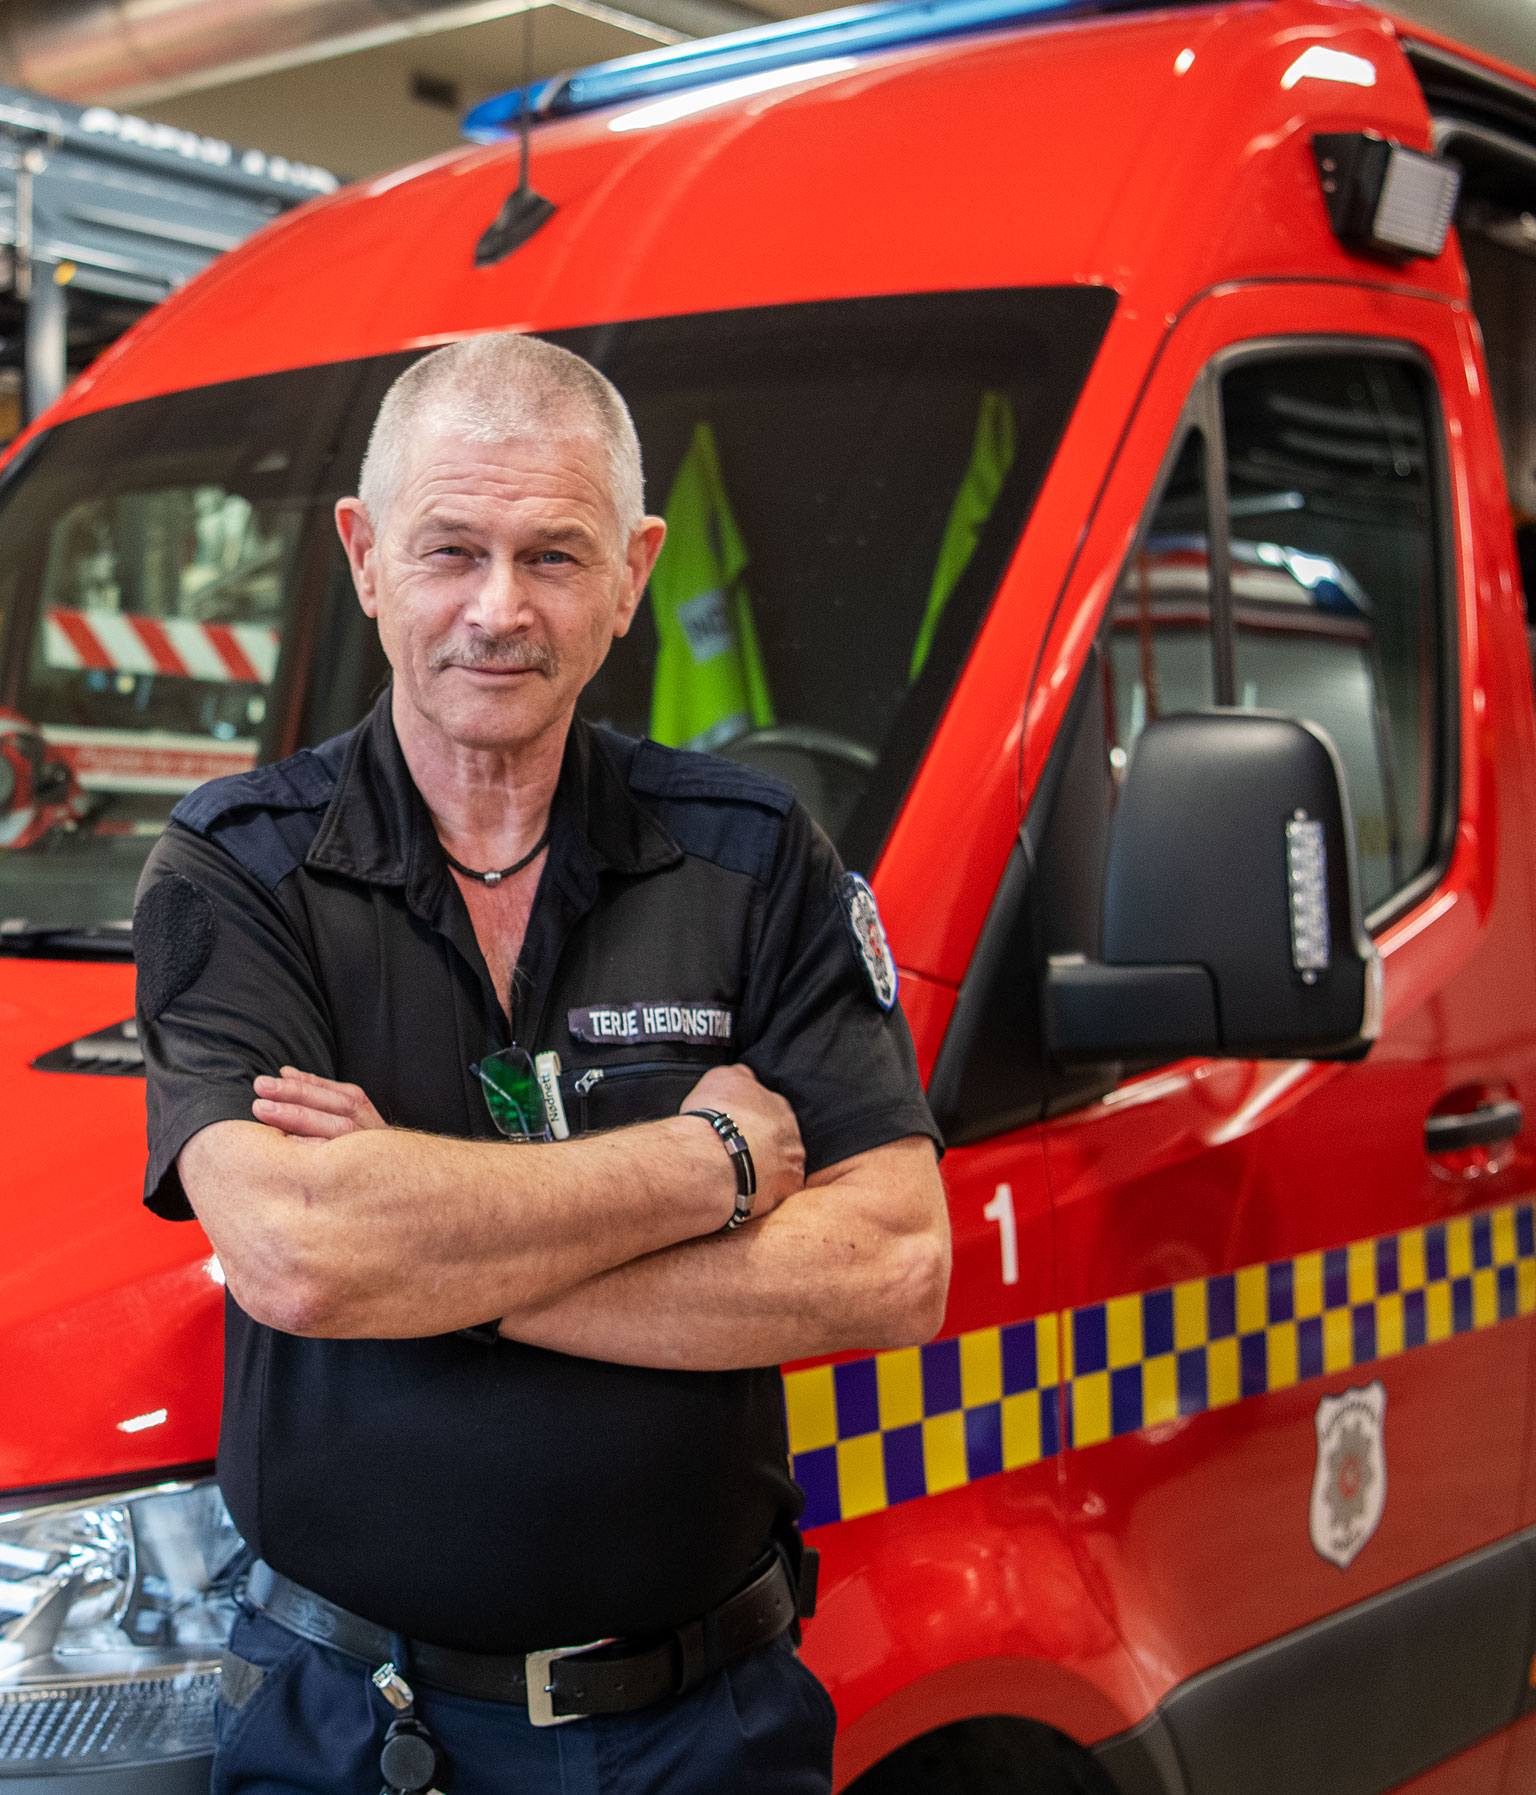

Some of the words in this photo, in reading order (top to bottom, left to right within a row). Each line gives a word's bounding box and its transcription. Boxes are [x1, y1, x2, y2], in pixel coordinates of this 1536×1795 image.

[588, 1010, 639, 1038] TERJE
[542, 1072, 561, 1122] Nødnett
[983, 1182, 1019, 1286] 1
